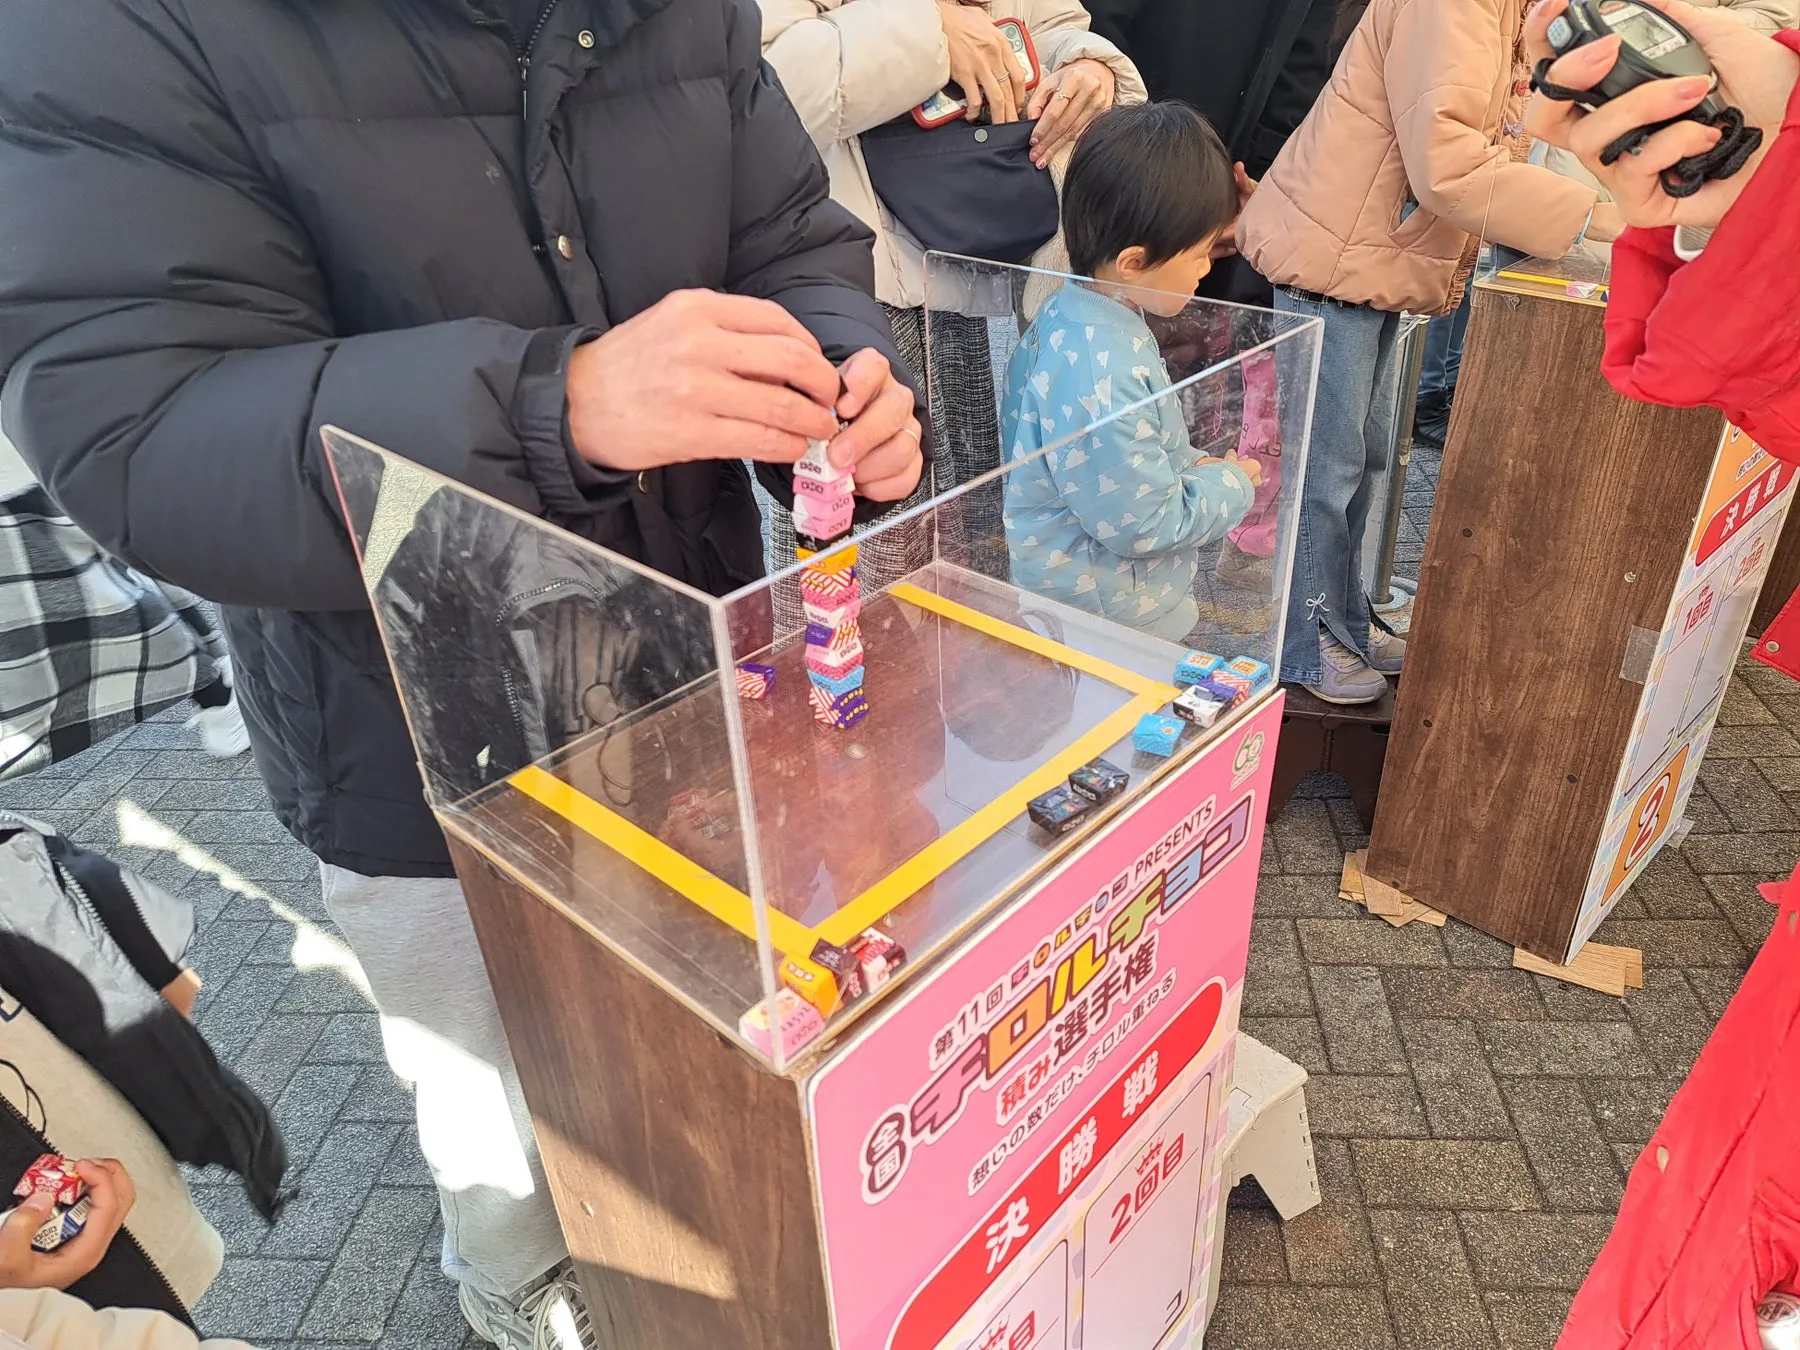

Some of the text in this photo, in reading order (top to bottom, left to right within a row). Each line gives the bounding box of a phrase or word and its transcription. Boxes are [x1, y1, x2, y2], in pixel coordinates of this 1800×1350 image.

[1627, 780, 1667, 862] 2
[910, 796, 1250, 1139] チロルチョコ
[934, 800, 1213, 1059] 第11回 チロルチョコ PRESENTS
[1002, 936, 1155, 1117] 積み選手権
[870, 1116, 902, 1183] 全国
[972, 974, 1174, 1190] 想いの数だけ、チロル重ねる
[985, 1050, 1160, 1275] 決勝戦
[1109, 1133, 1184, 1244] 2回目
